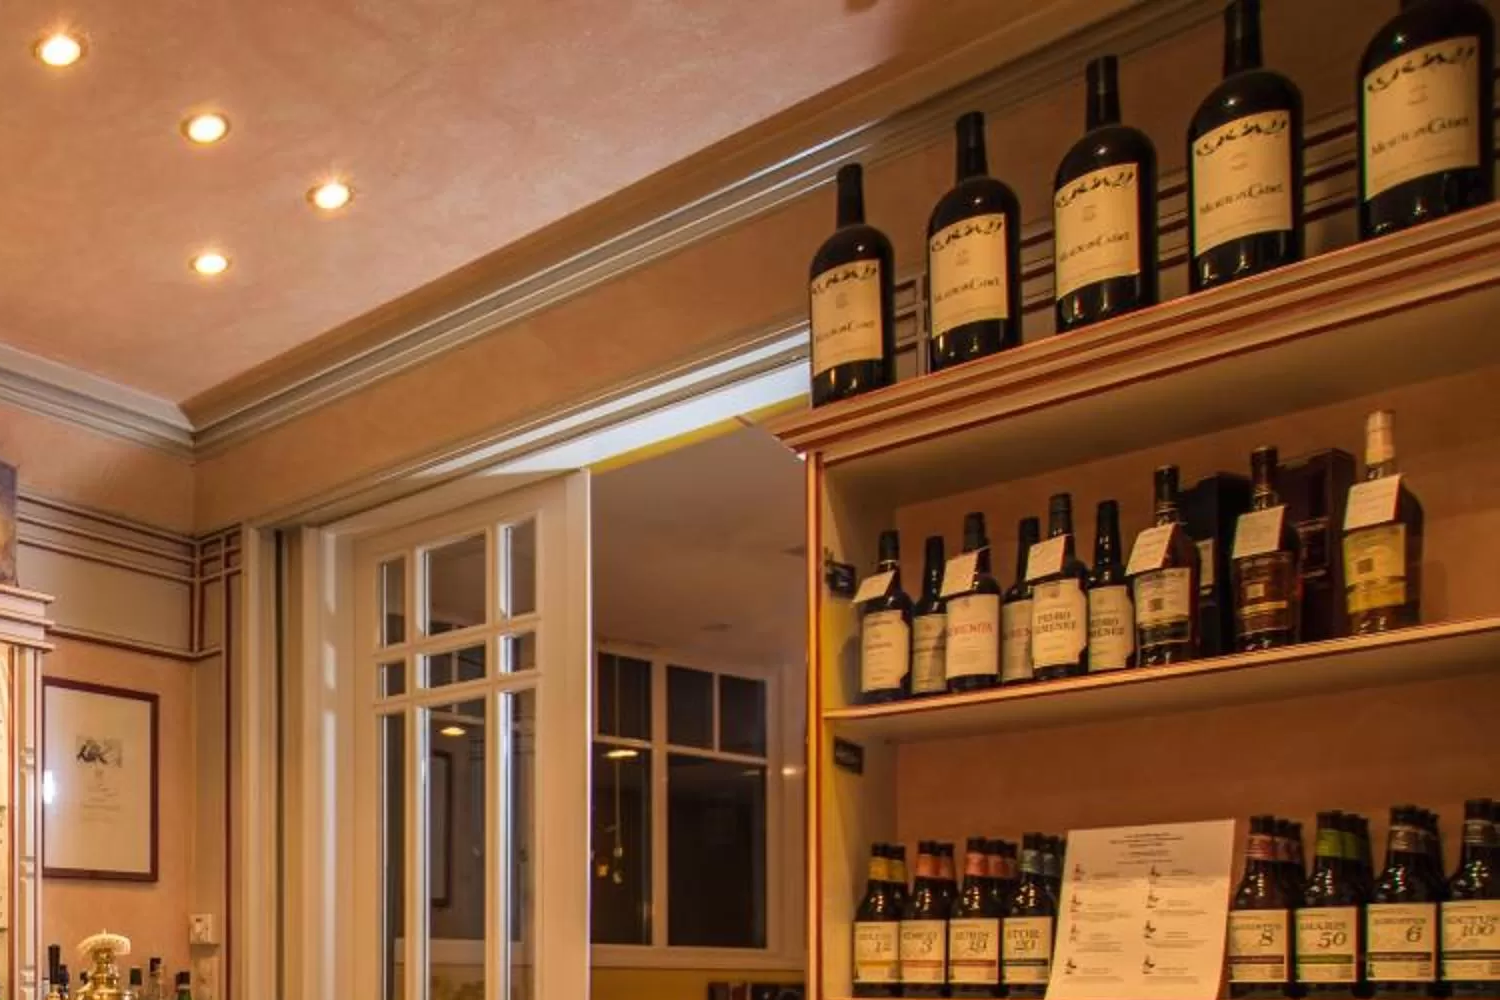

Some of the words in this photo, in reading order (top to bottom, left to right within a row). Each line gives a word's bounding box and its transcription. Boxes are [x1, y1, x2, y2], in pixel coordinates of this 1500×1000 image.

[1260, 930, 1275, 948] 8
[1317, 931, 1348, 948] 50
[1405, 925, 1423, 943] 6
